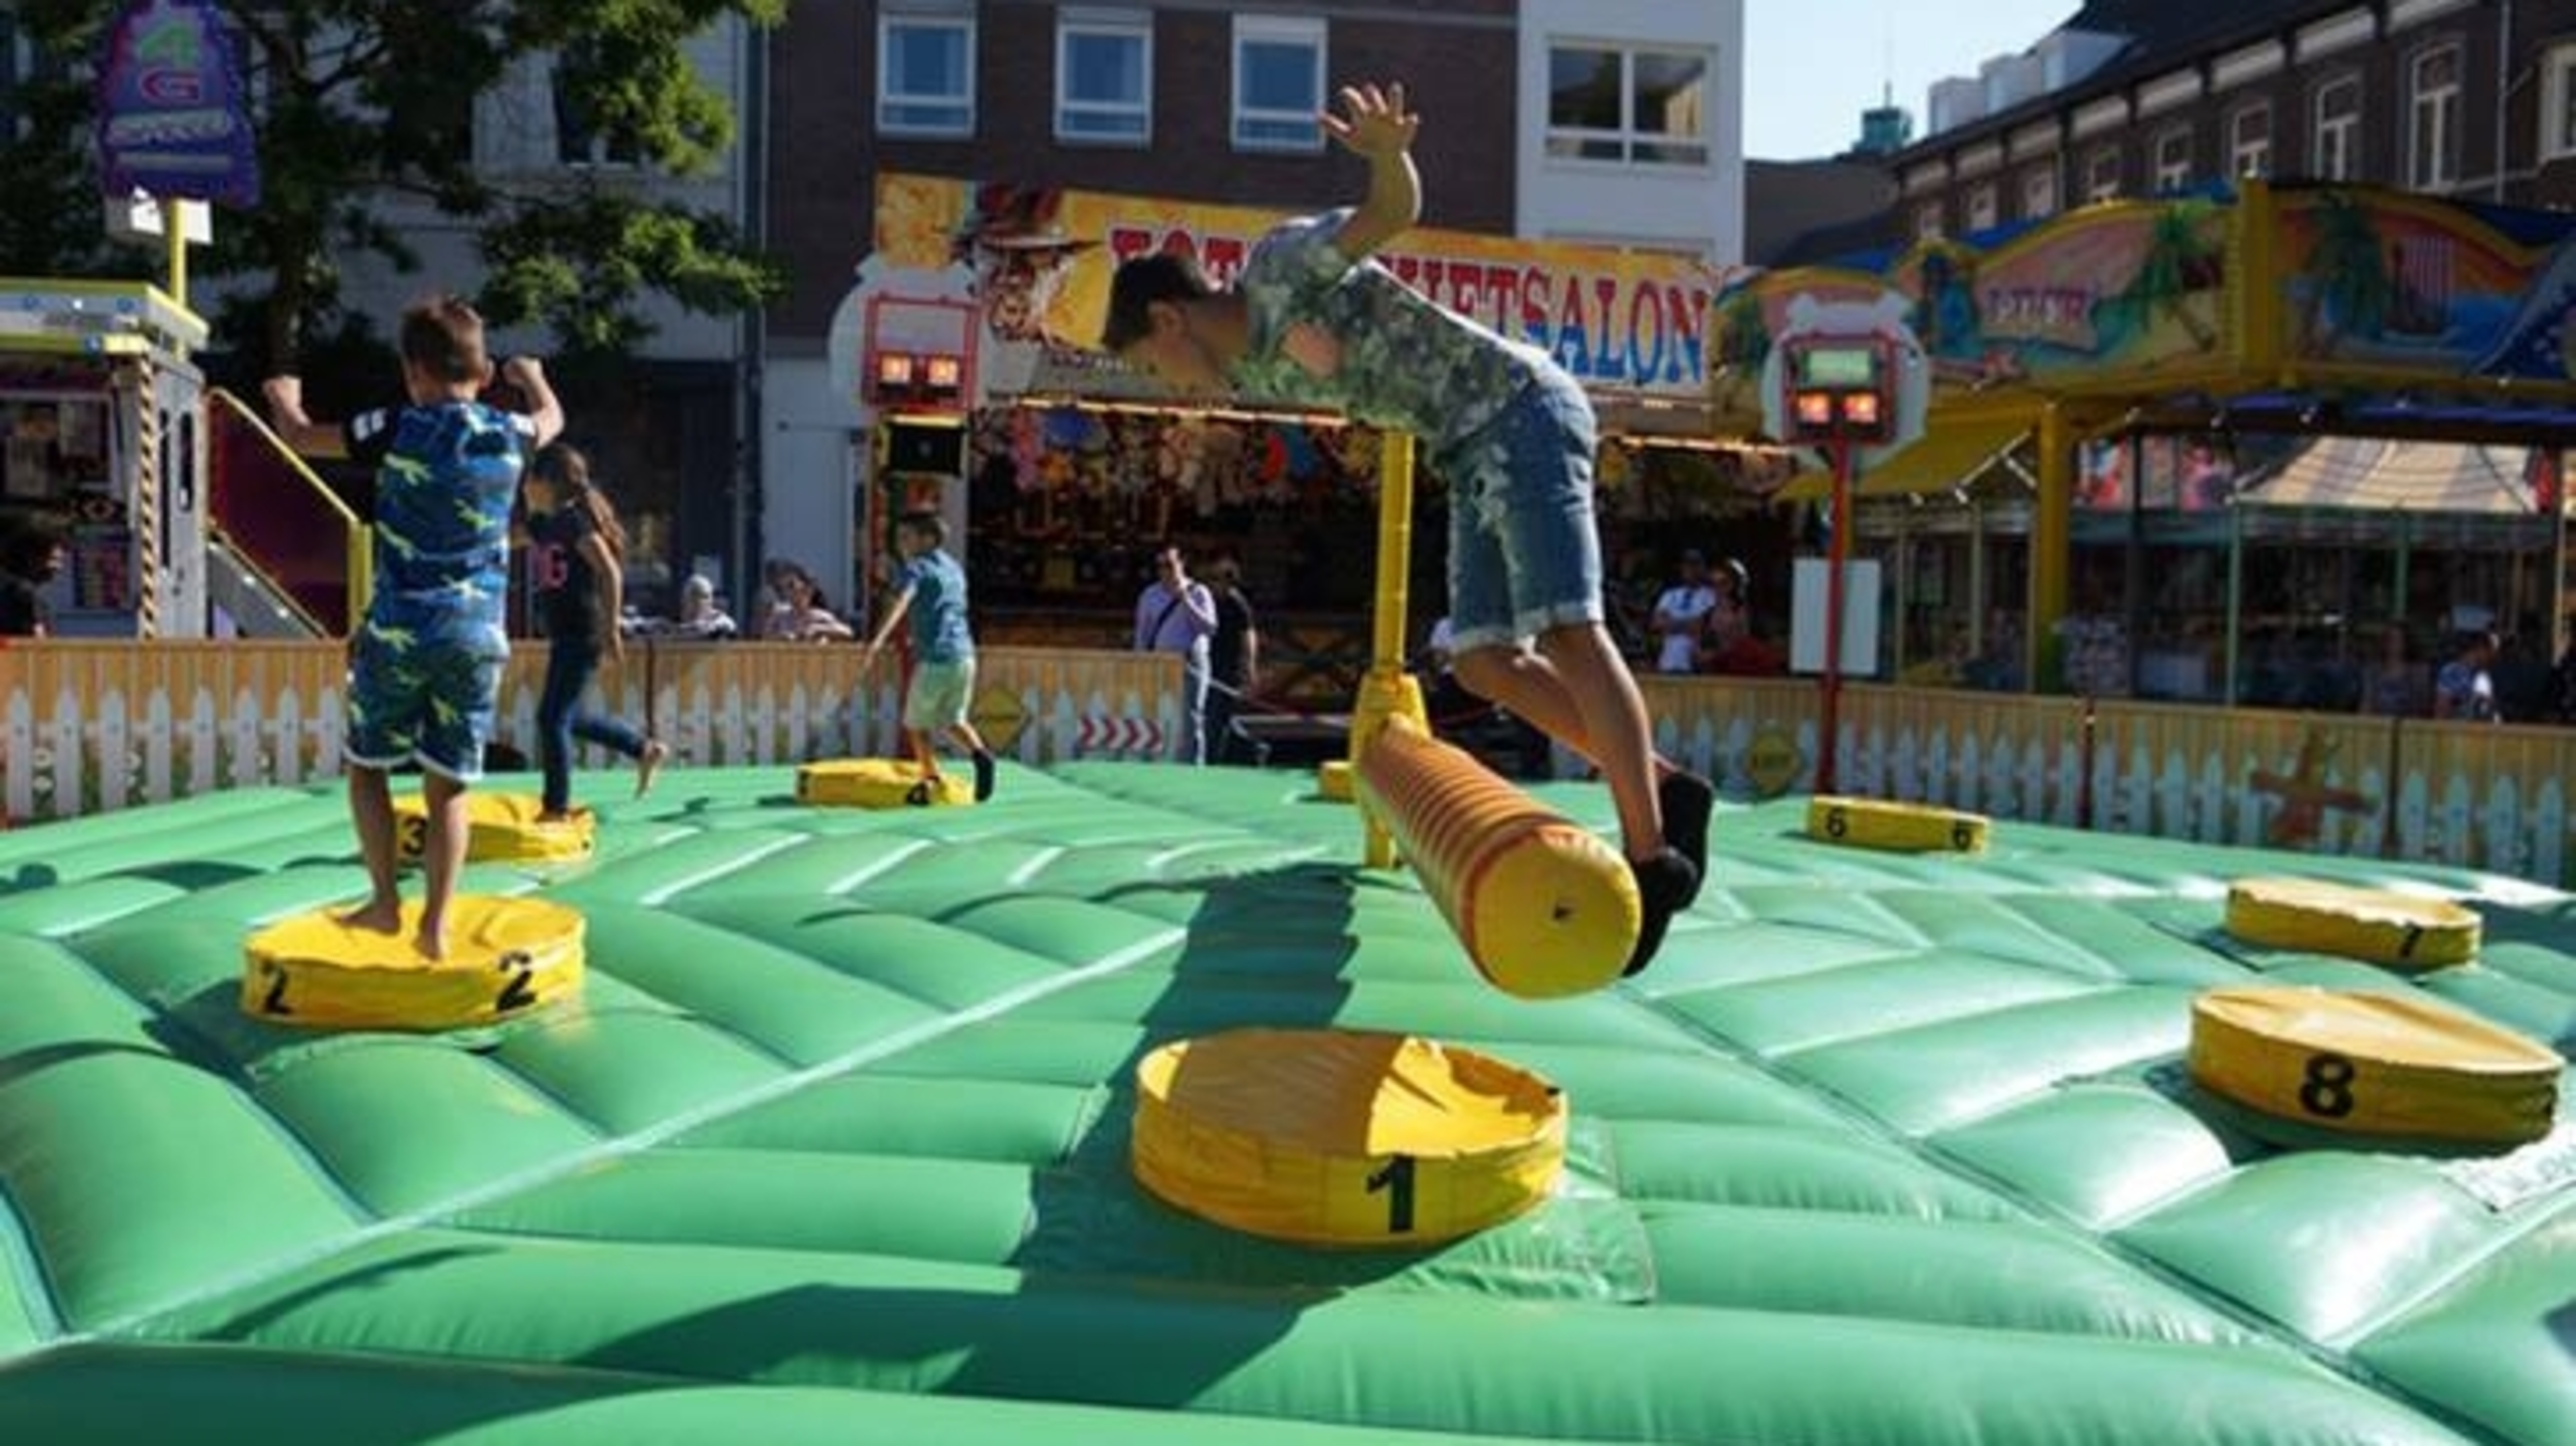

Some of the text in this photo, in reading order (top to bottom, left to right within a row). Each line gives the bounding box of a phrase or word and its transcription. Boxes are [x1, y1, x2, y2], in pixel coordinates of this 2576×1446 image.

[402, 815, 427, 856] 3
[1825, 807, 1847, 837] 6
[496, 952, 537, 1012] 2
[2300, 1053, 2355, 1118] 8
[1366, 1153, 1414, 1233] 1
